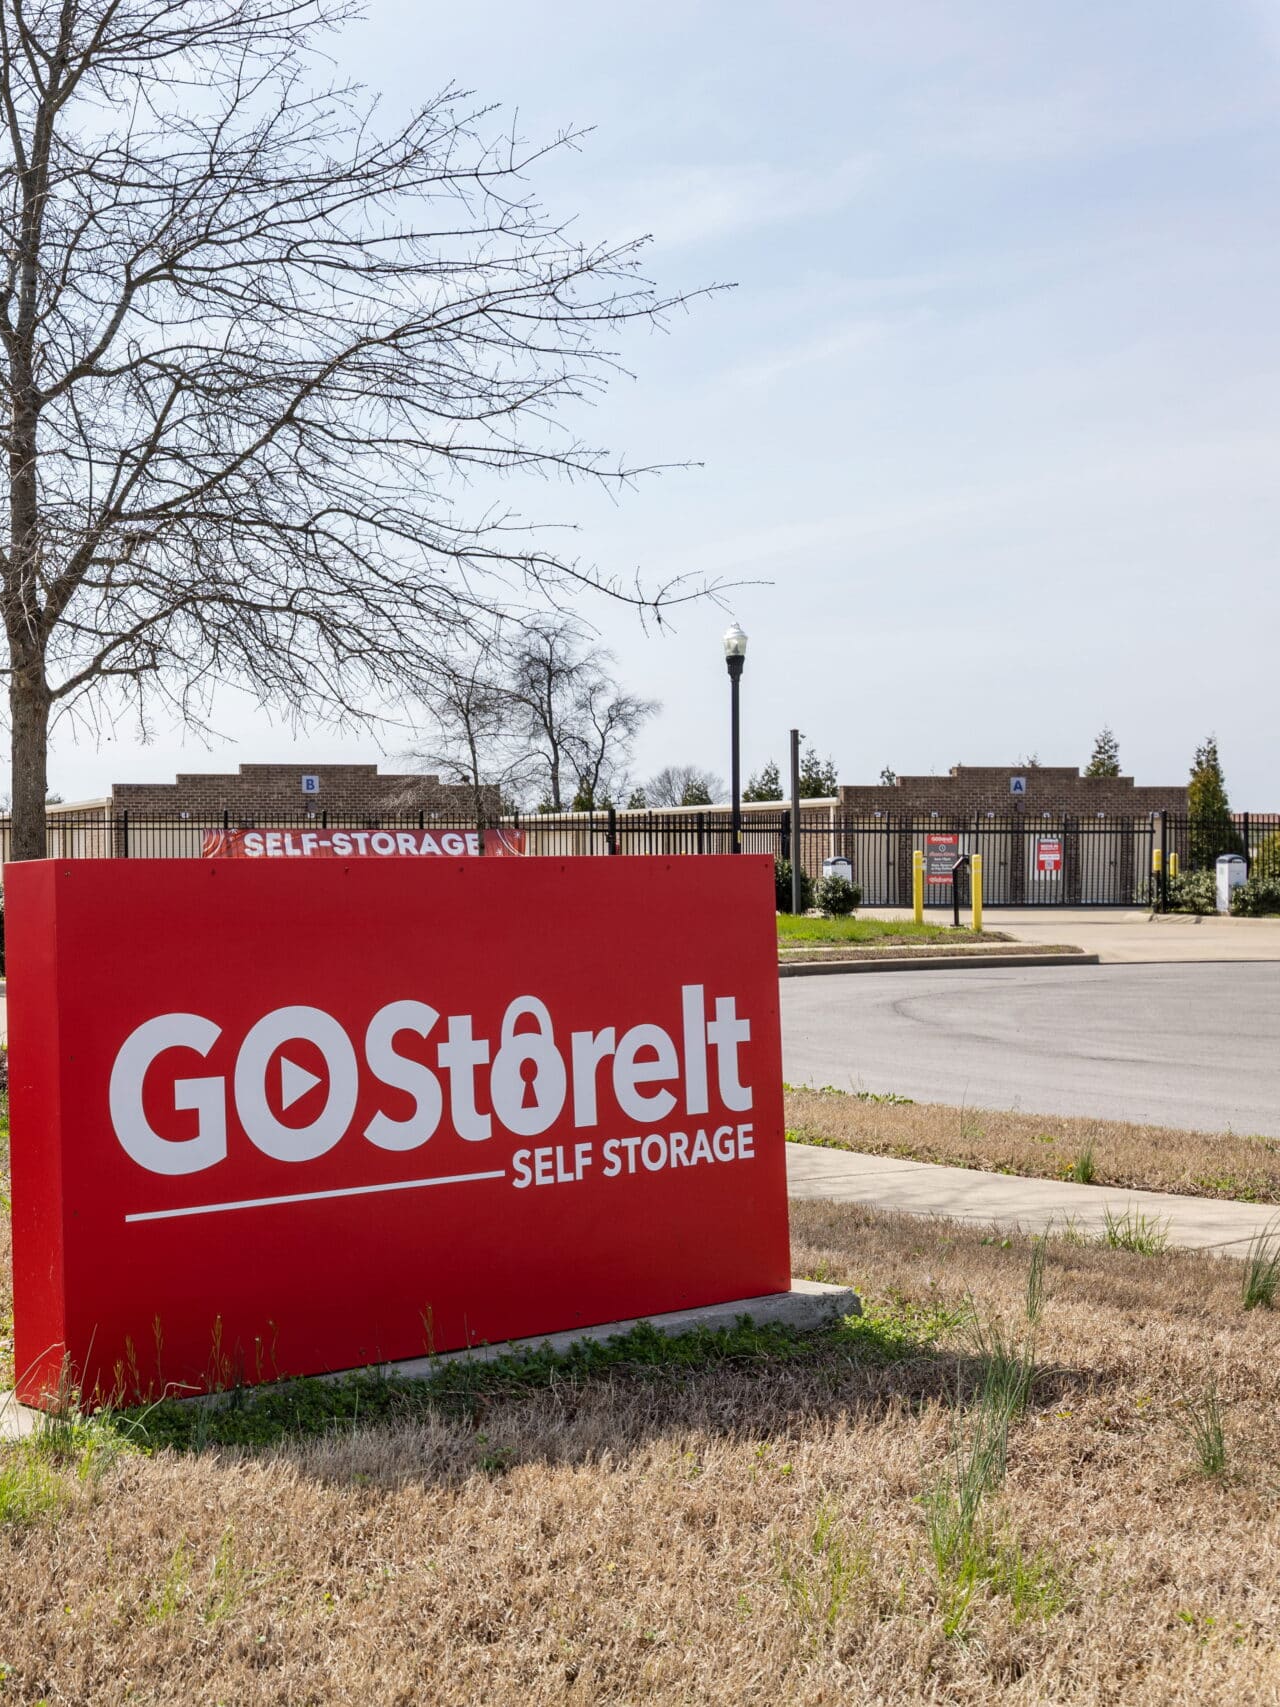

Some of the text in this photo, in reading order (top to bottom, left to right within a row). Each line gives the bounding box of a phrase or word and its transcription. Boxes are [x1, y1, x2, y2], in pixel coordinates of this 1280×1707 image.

[306, 779, 315, 790] B
[1013, 780, 1023, 791] A
[108, 984, 754, 1176] GOStoreIt
[511, 1123, 756, 1189] SELF STORAGE
